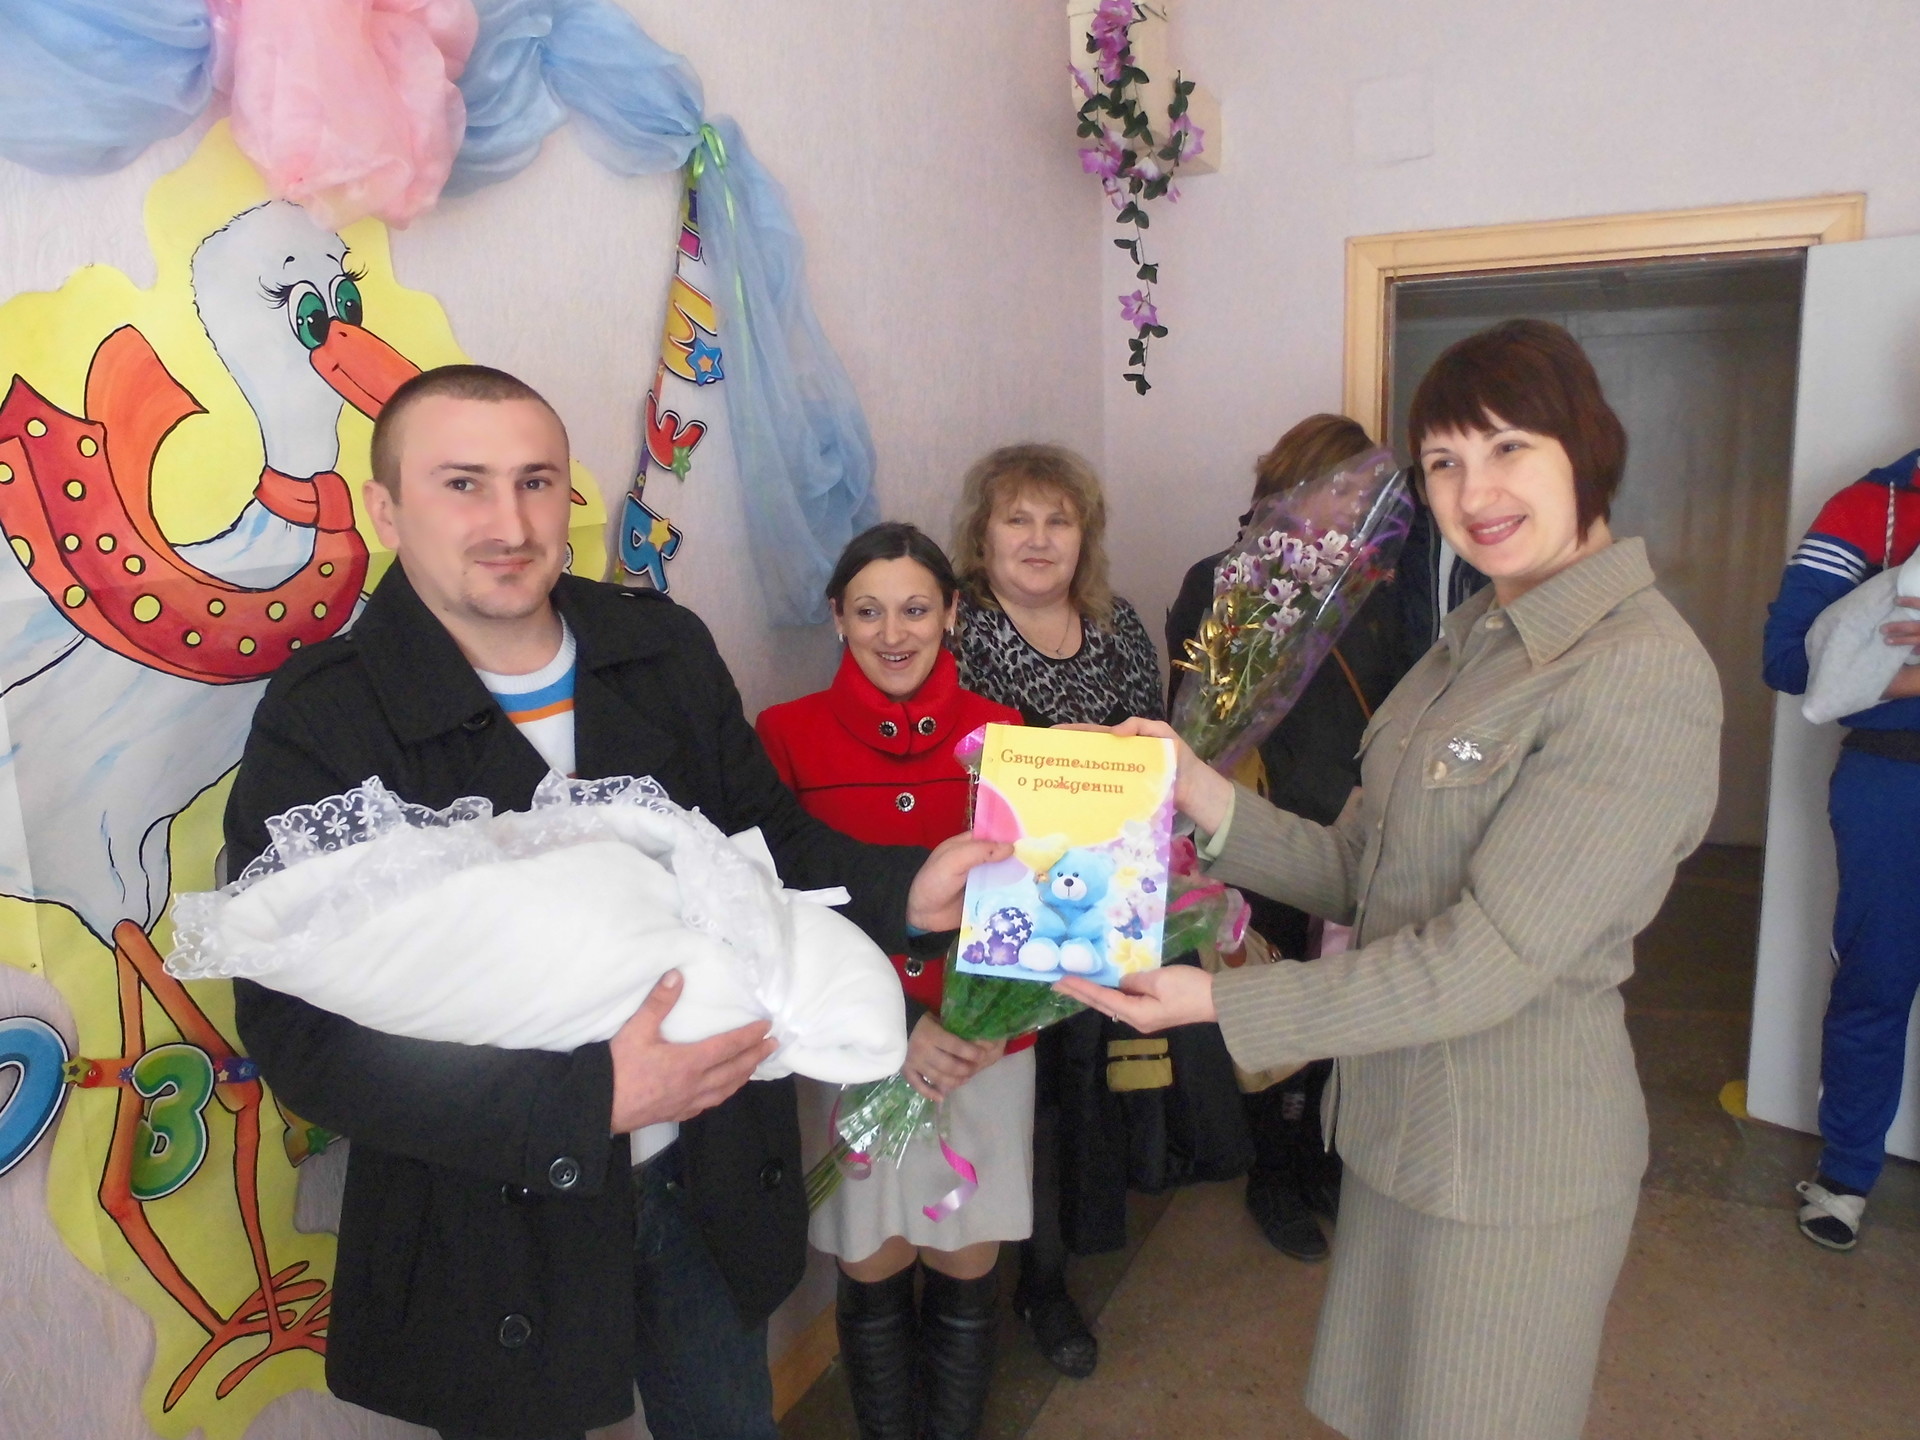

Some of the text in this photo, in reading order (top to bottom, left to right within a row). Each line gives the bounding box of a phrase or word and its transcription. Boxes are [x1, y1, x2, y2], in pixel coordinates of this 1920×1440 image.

[1000, 748, 1146, 774] Свидетельство
[1017, 776, 1124, 795] о рождении
